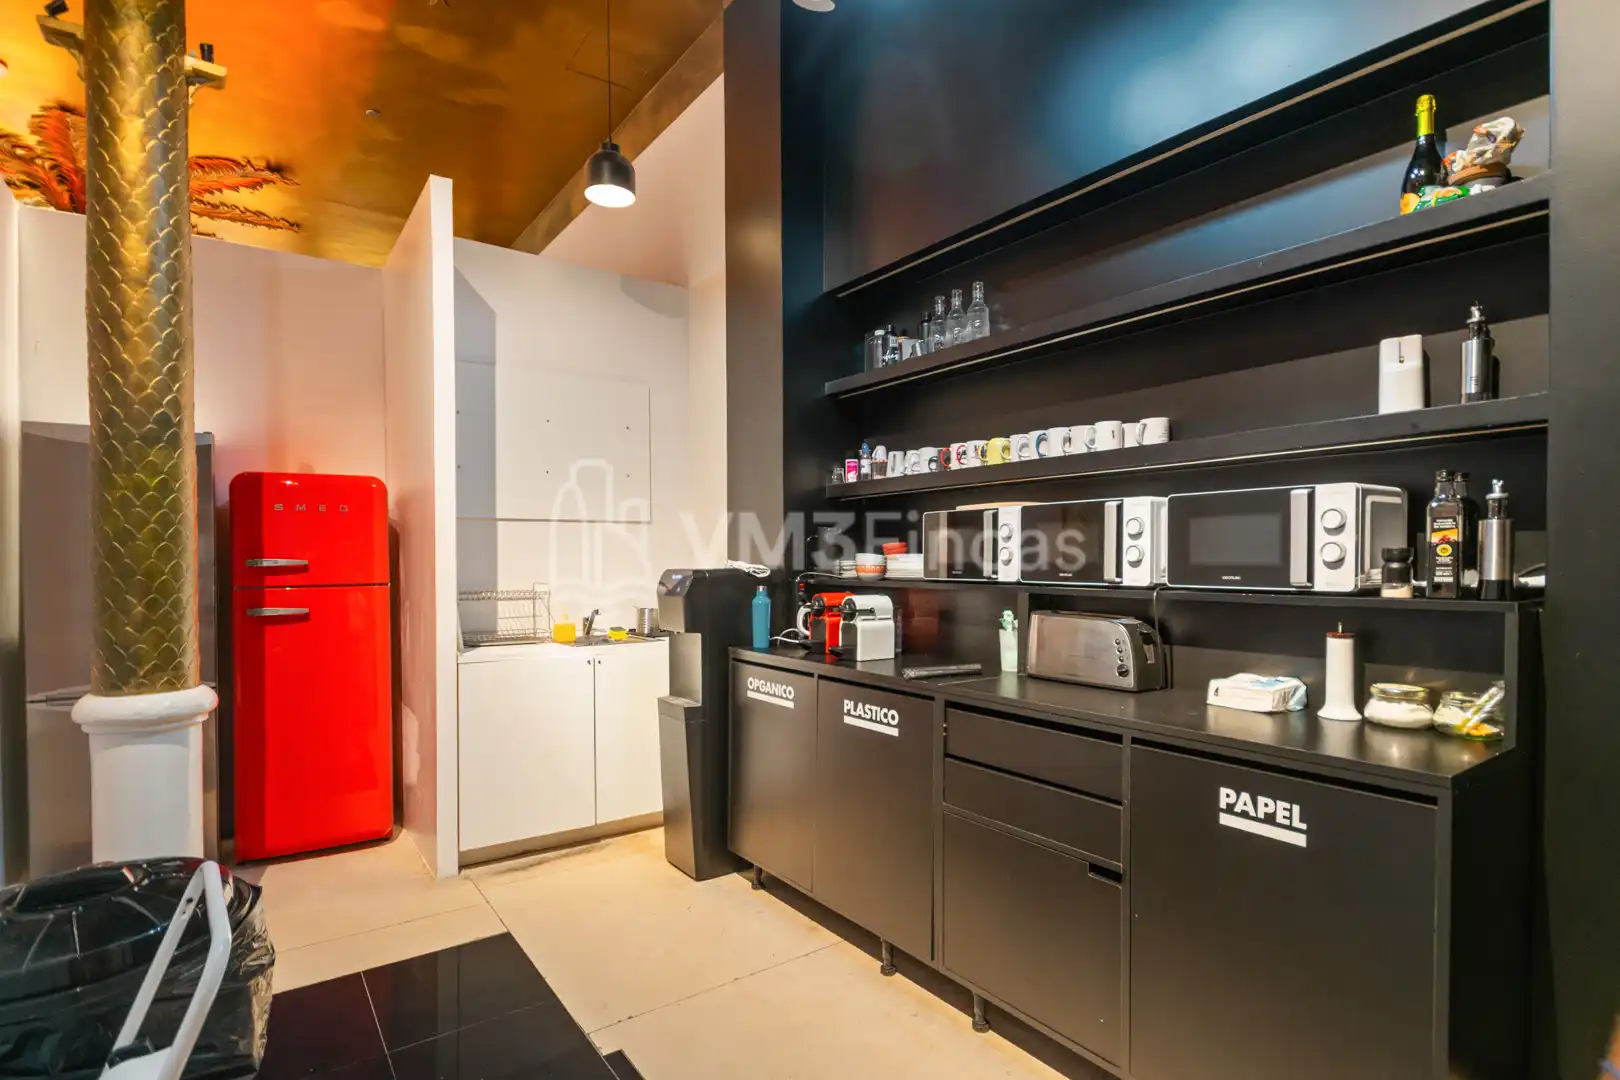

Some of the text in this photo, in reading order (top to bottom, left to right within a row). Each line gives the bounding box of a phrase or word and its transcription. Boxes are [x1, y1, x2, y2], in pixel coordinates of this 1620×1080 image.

[274, 503, 349, 512] SMEG
[843, 699, 899, 726] PLASTICO
[1219, 787, 1307, 830] PAPEL
